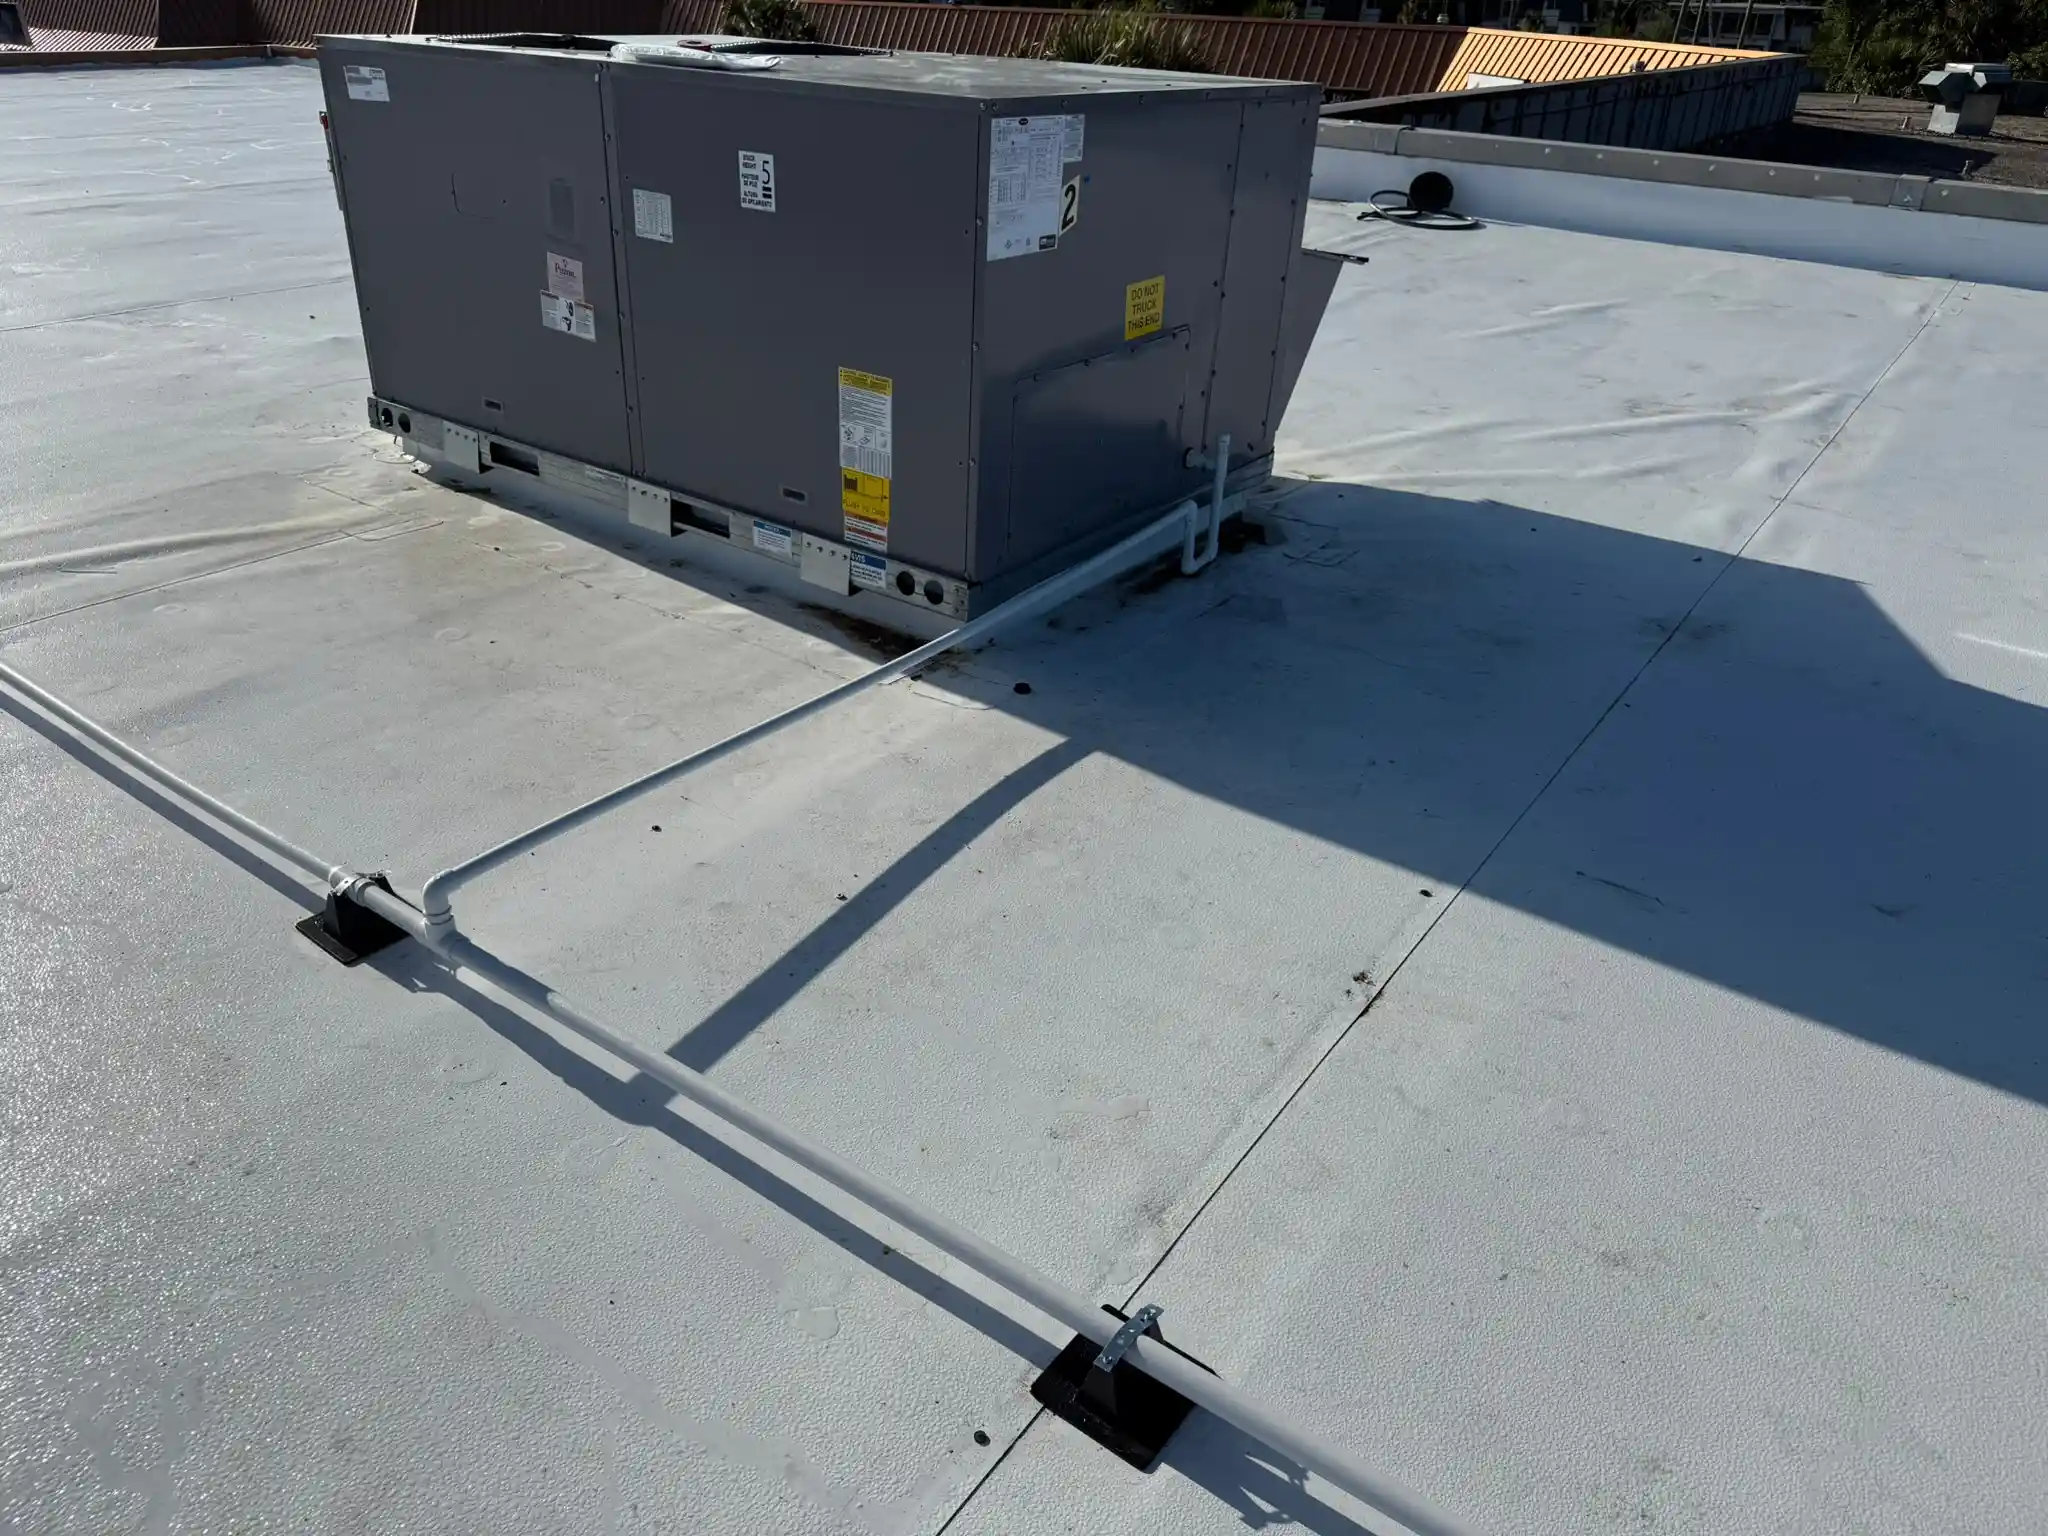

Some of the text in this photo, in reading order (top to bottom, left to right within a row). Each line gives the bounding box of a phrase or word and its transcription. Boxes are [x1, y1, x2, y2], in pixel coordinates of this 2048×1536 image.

[762, 160, 770, 185] 5
[1061, 184, 1076, 231] 2
[1131, 283, 1160, 300] DO NOT
[1132, 299, 1157, 315] TRUCK
[1128, 312, 1160, 333] THIS END
